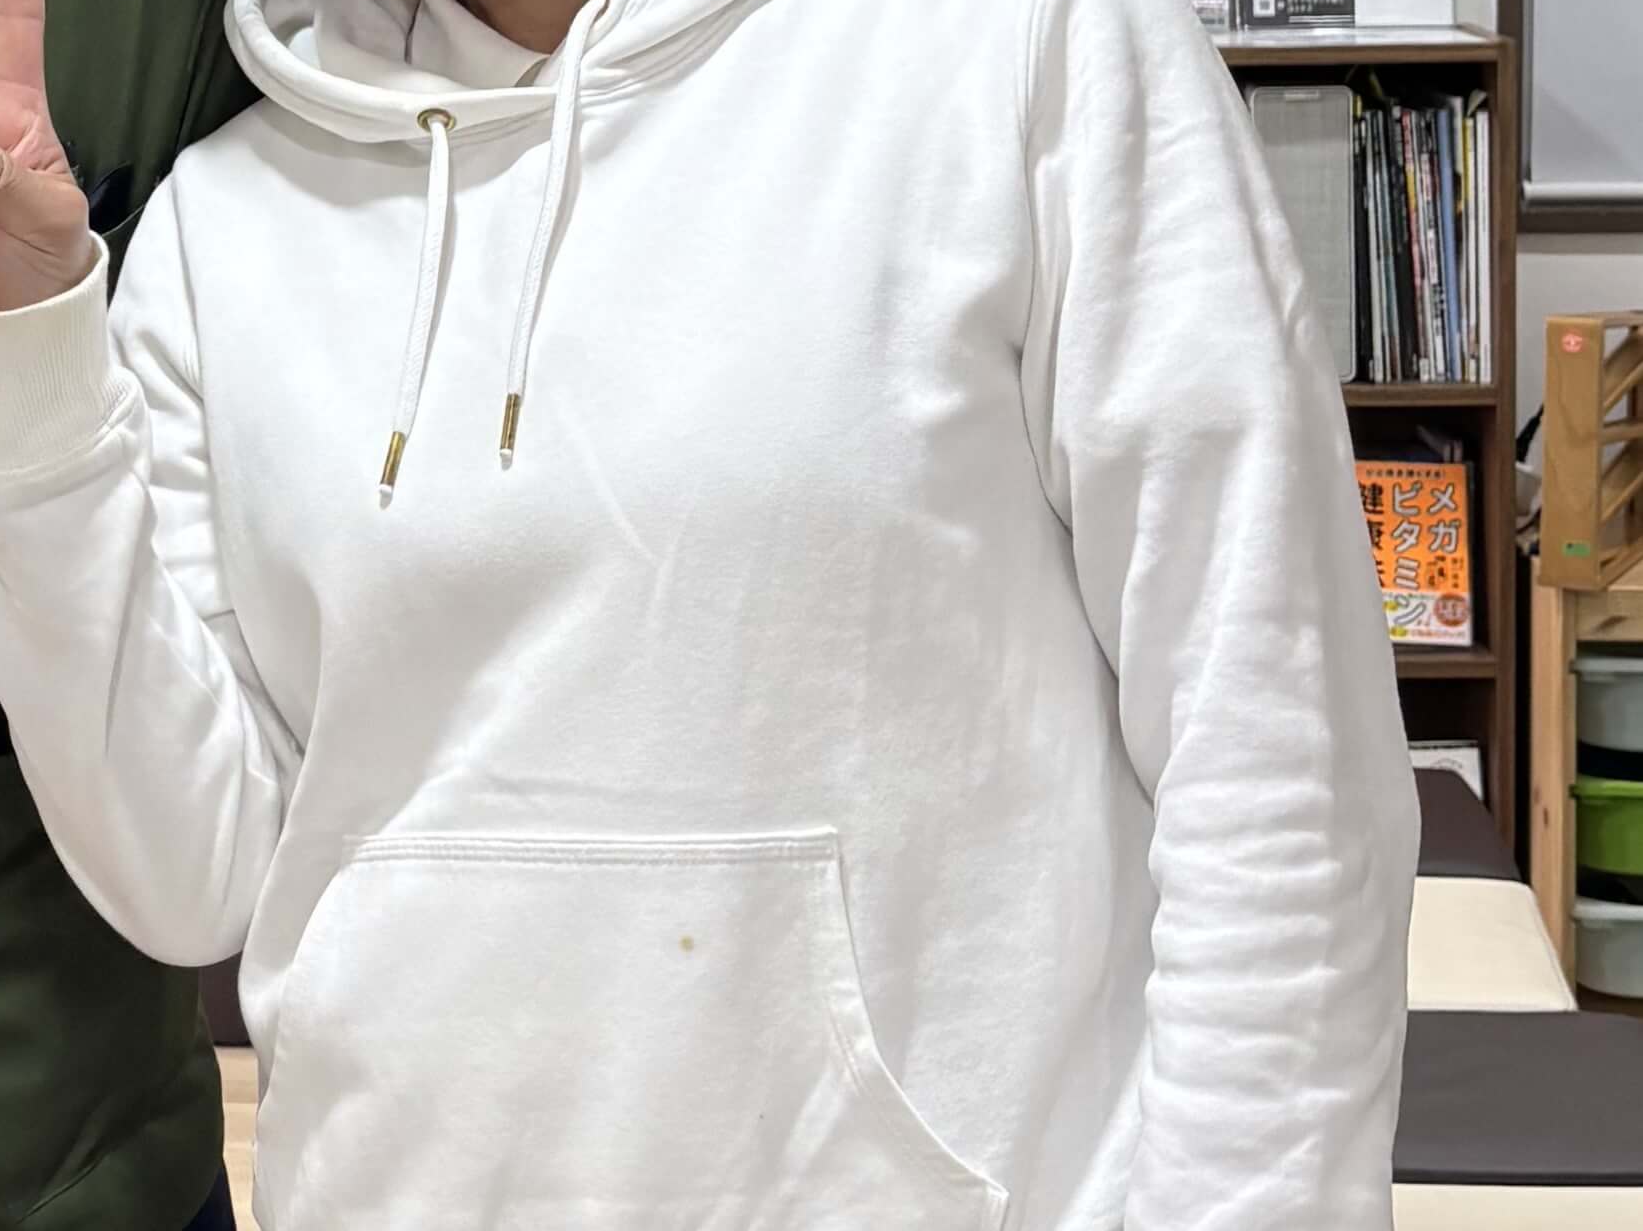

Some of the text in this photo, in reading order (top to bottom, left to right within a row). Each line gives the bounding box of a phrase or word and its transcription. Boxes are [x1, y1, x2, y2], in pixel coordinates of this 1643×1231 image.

[1391, 480, 1427, 627] ビタミン
[1426, 481, 1461, 554] メガ
